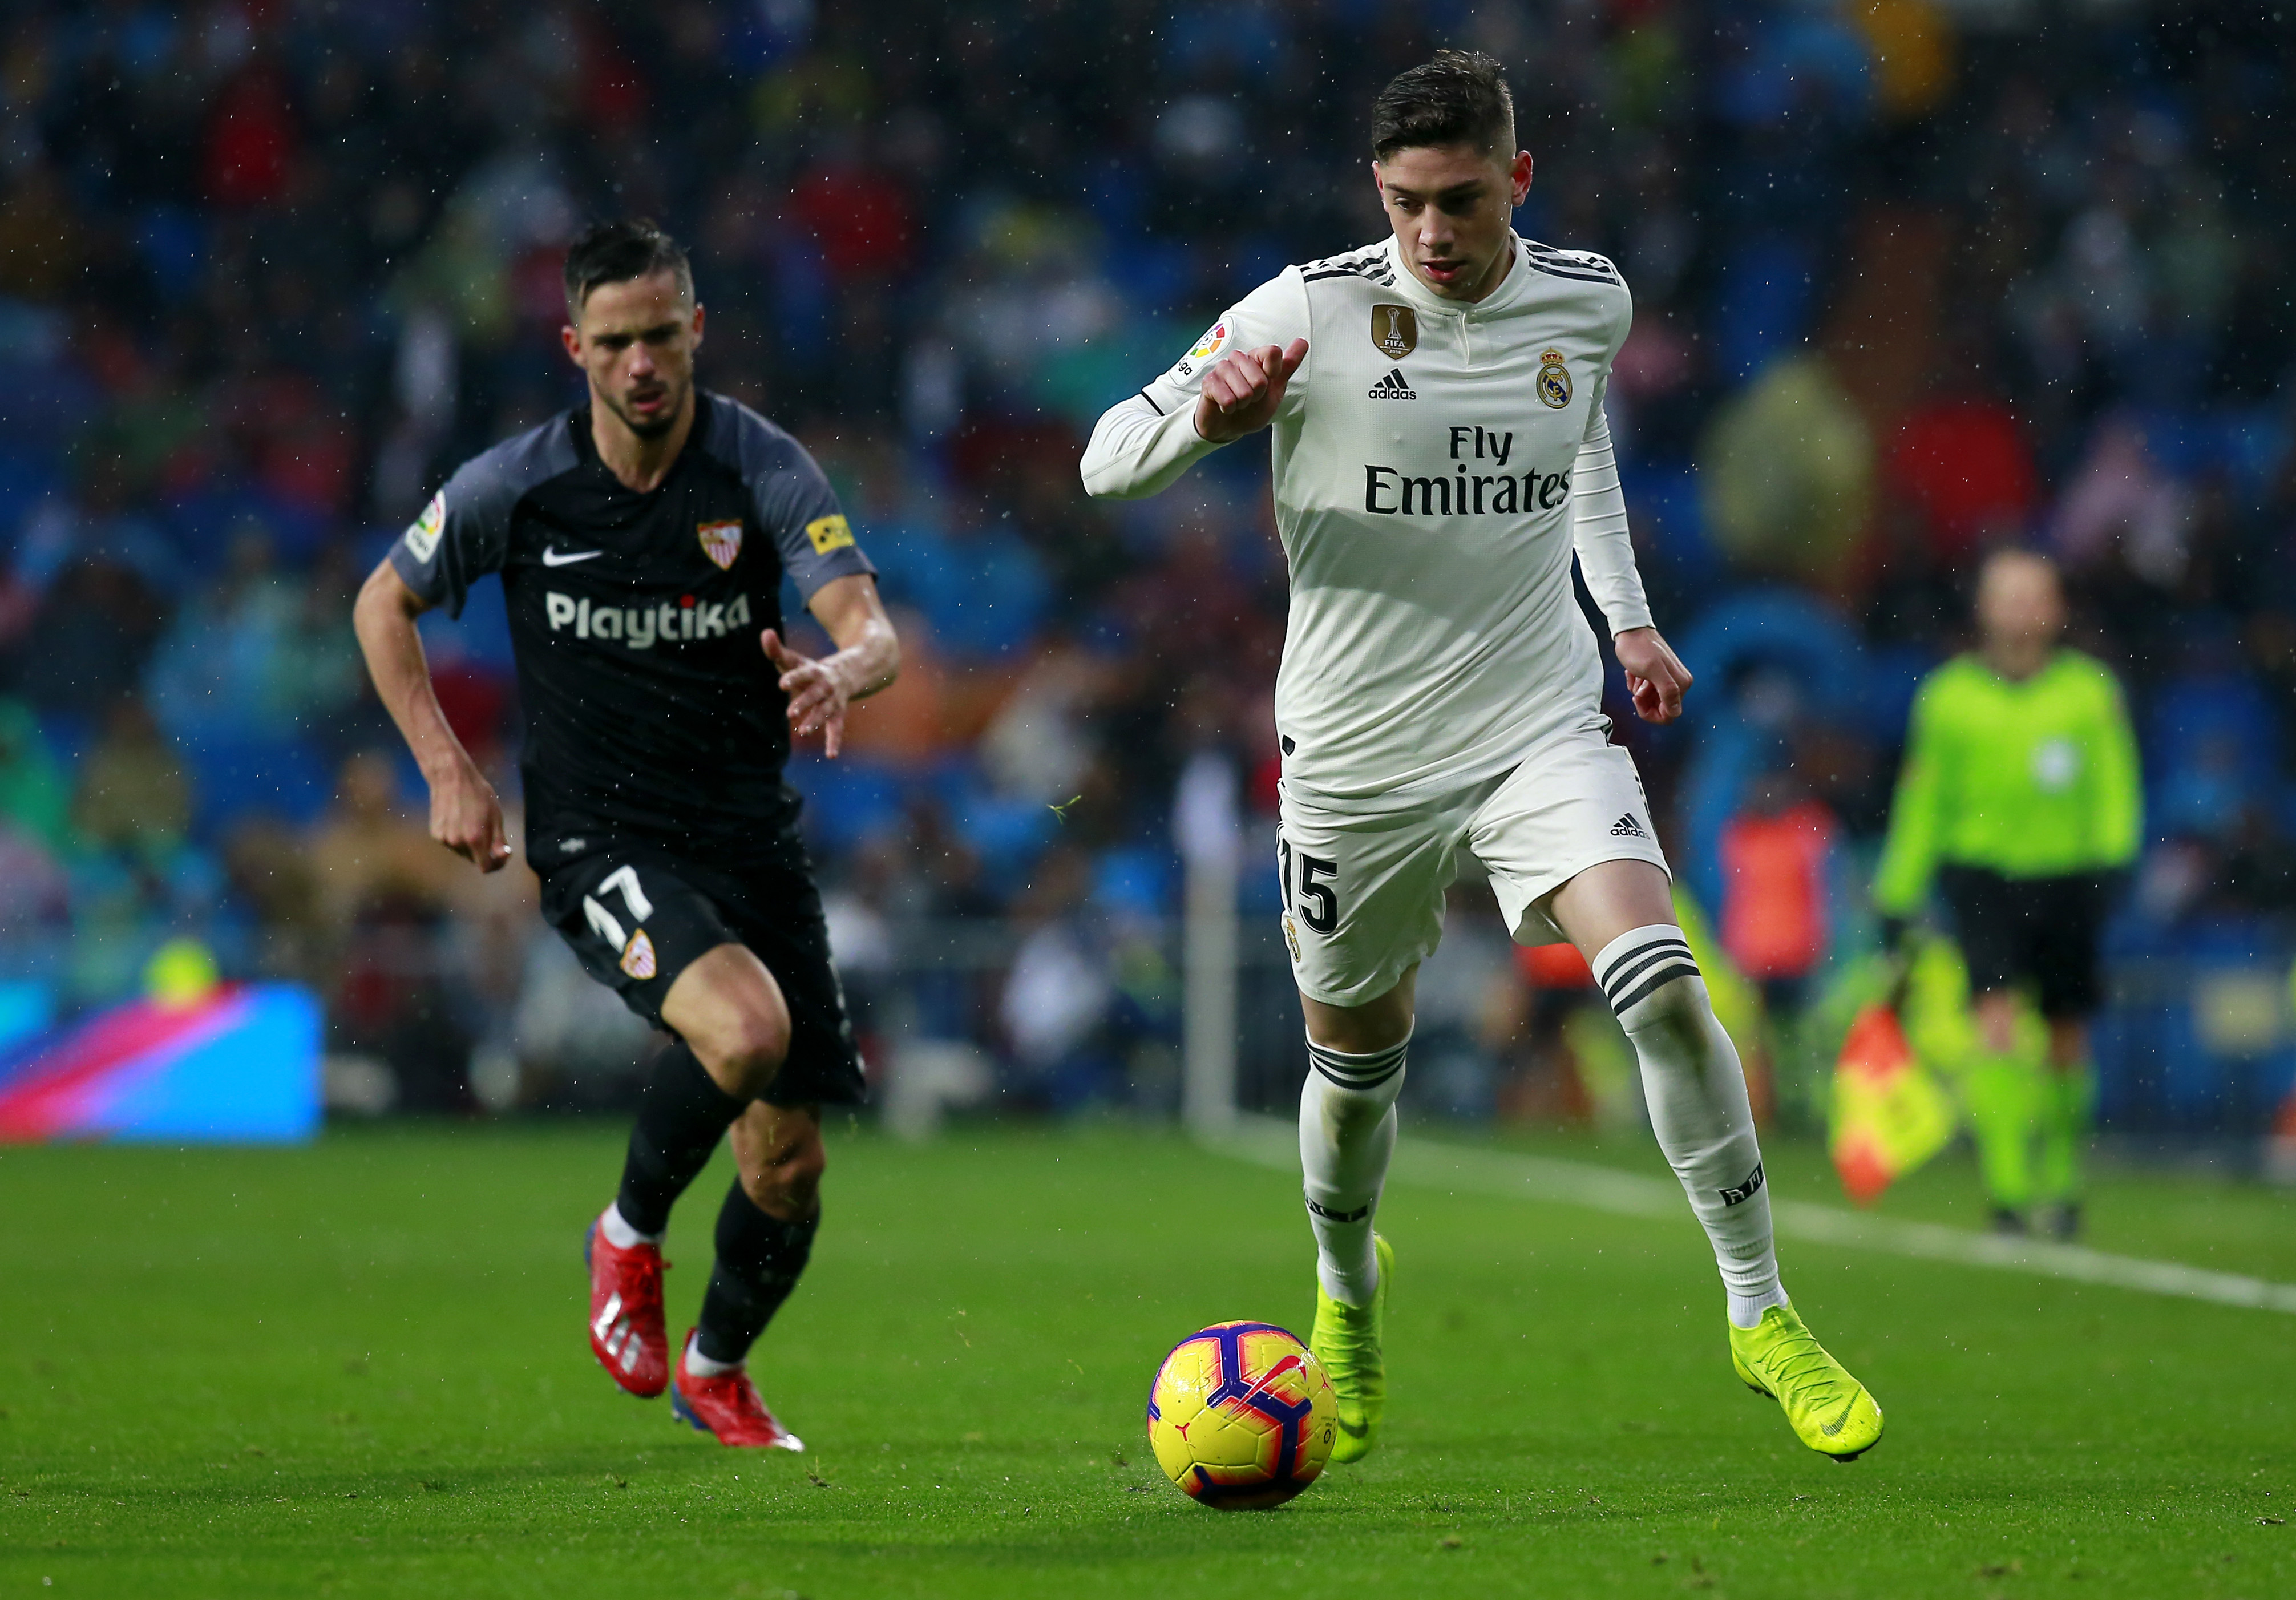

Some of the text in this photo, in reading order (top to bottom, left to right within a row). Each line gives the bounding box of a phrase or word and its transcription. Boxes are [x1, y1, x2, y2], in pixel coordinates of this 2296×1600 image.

[1384, 339, 1405, 348] FIFA
[1368, 387, 1417, 400] adidas
[1449, 426, 1513, 466] Fly
[1364, 463, 1570, 516] Emirates
[546, 590, 751, 649] Playtika
[1610, 827, 1651, 841] adidas
[582, 864, 654, 953] 17
[1280, 838, 1338, 935] 15
